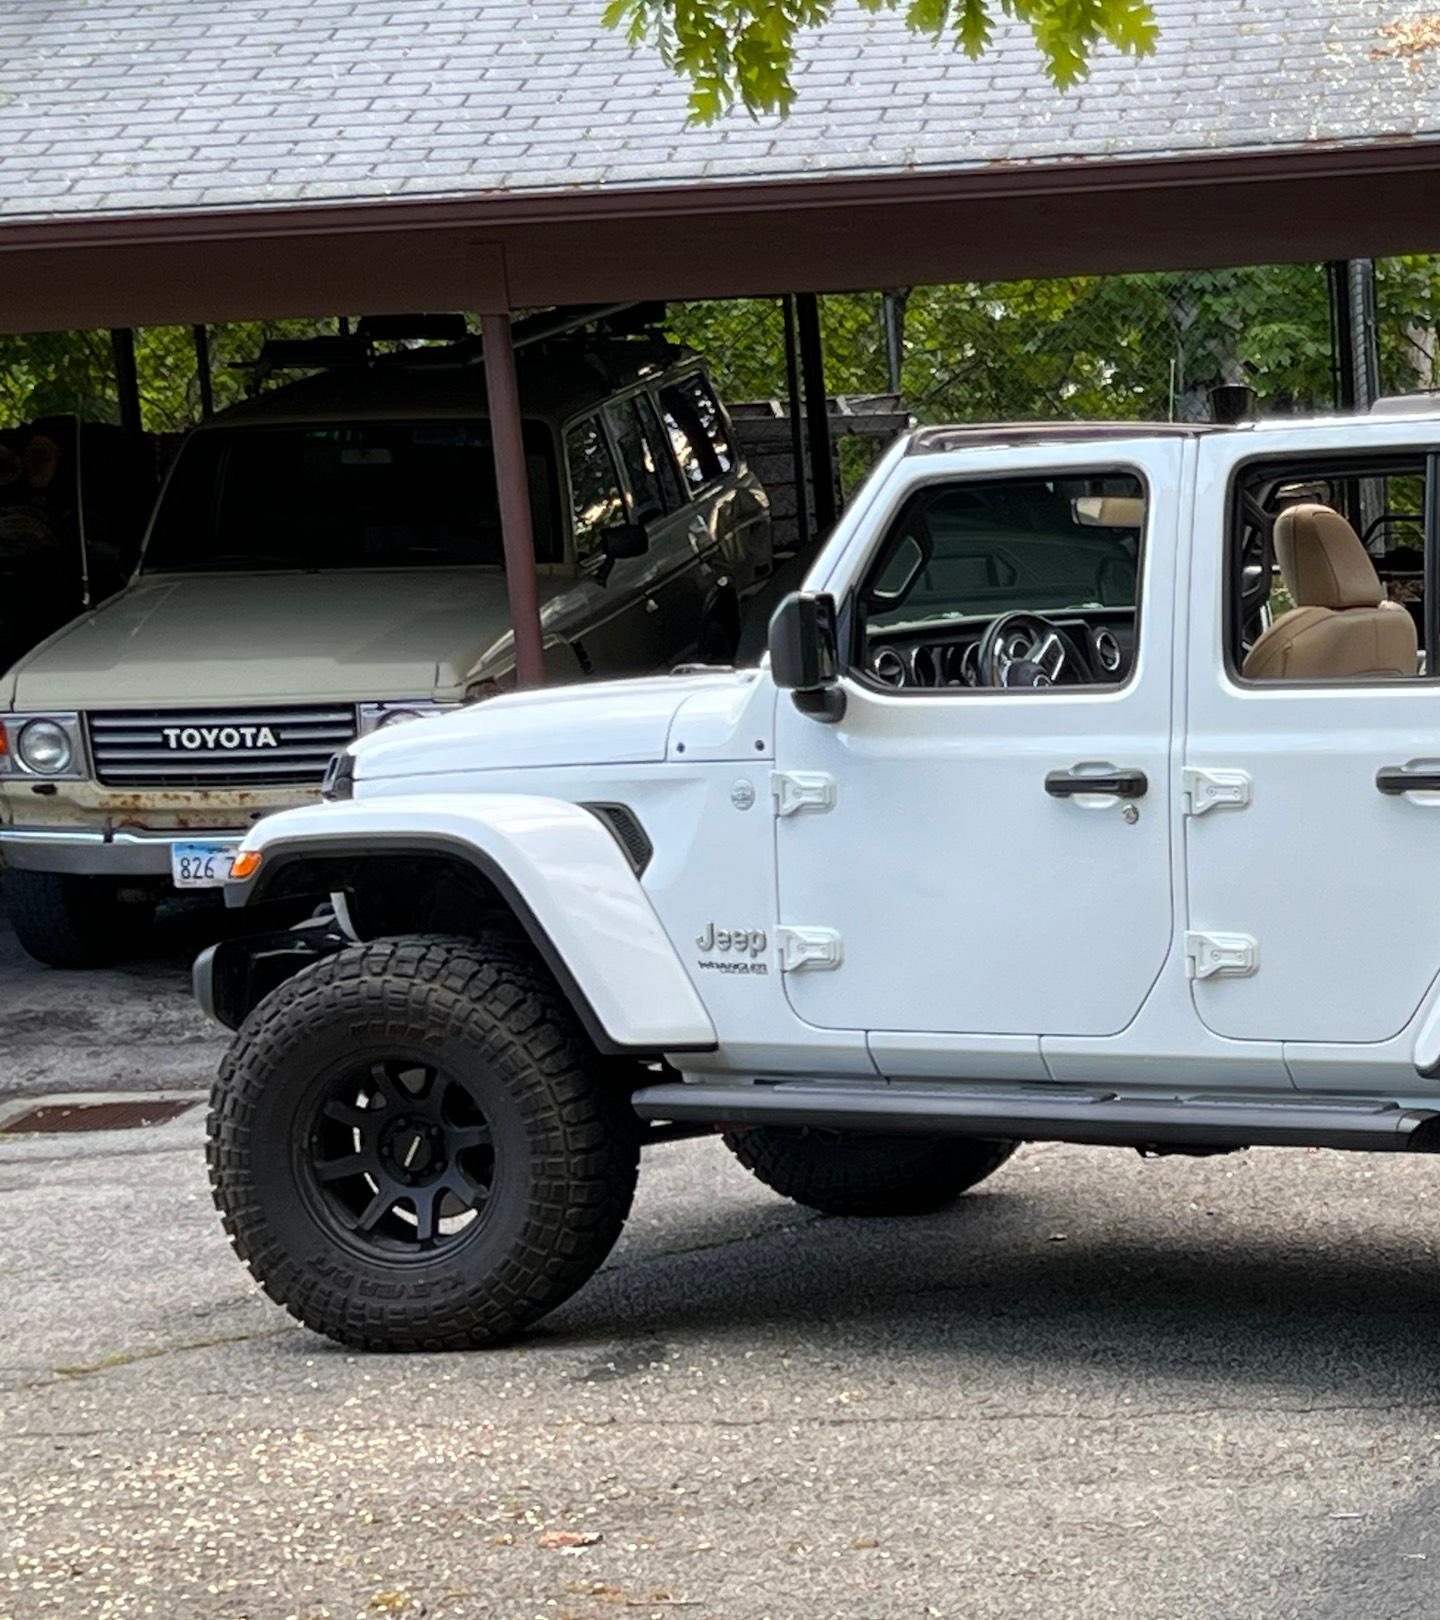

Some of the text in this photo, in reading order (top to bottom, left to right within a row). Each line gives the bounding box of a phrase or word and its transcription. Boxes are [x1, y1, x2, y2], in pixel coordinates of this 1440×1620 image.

[163, 727, 277, 749] TOYOTA
[180, 856, 215, 879] 826
[695, 922, 767, 958] Jeep
